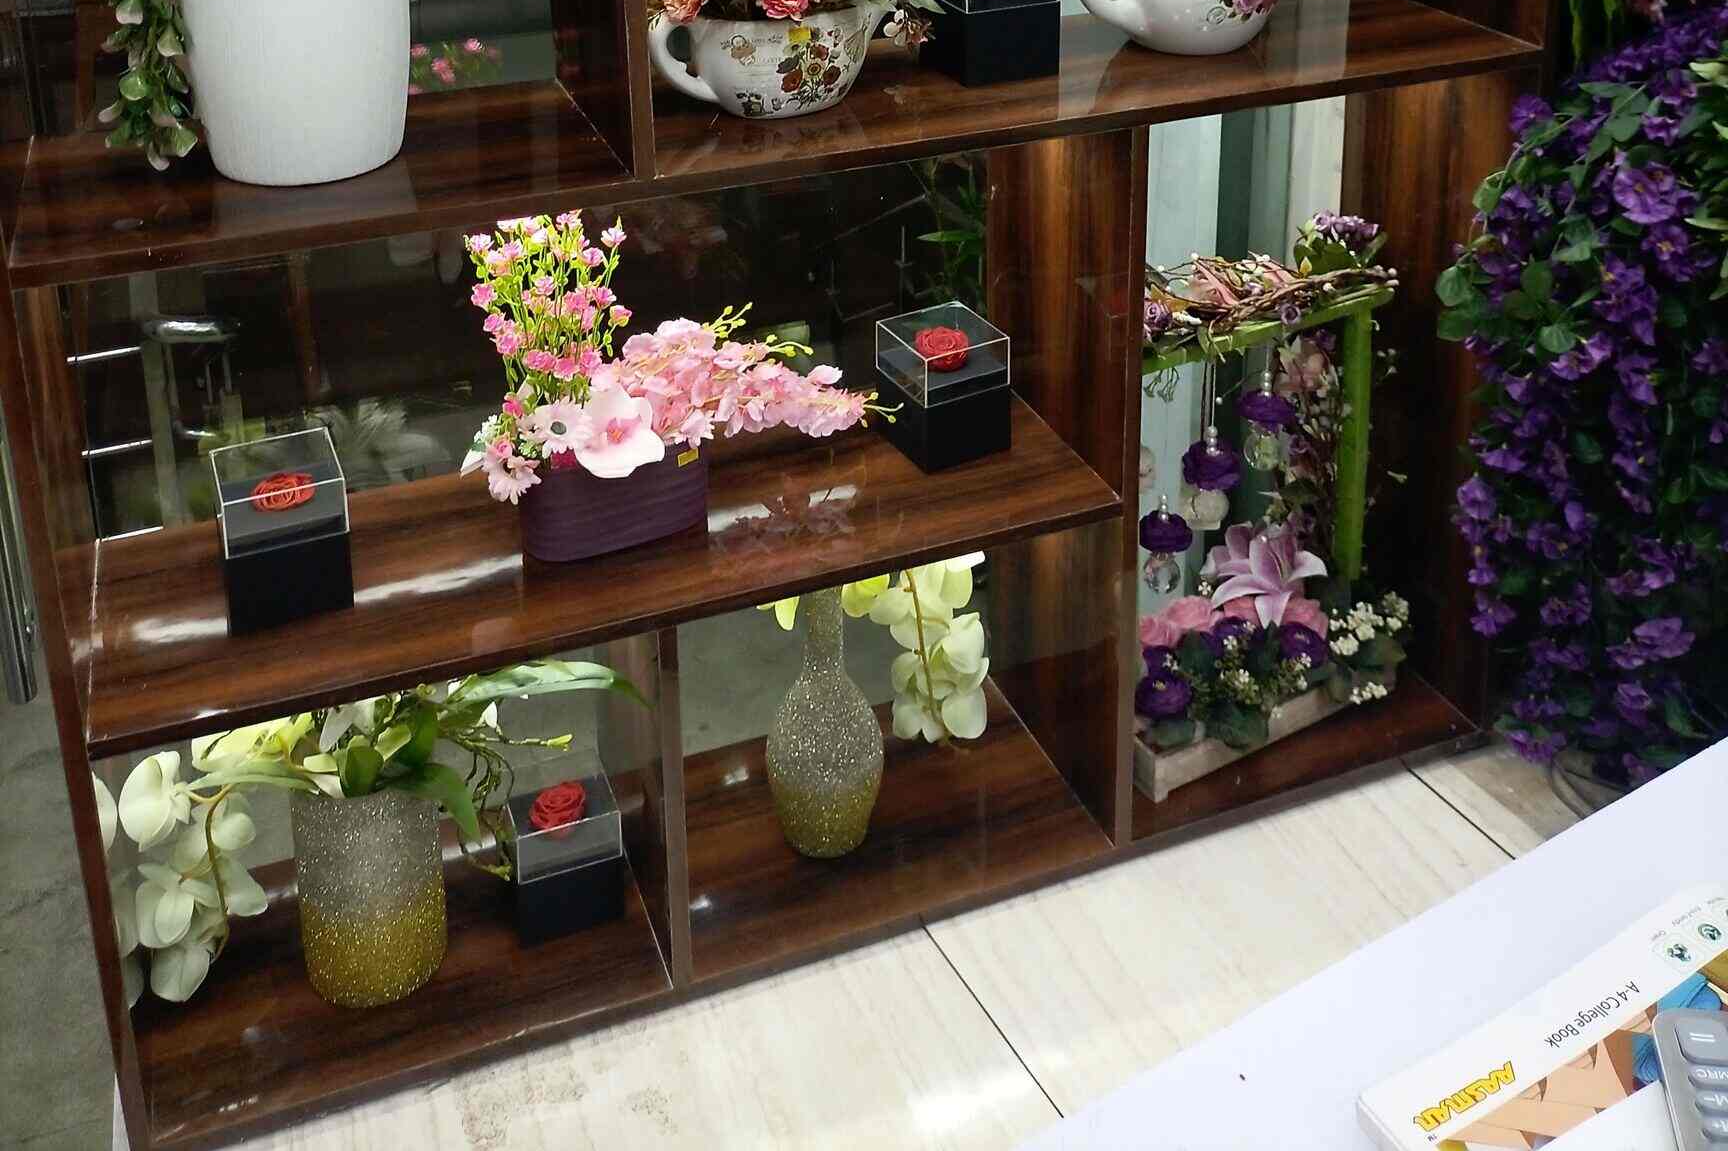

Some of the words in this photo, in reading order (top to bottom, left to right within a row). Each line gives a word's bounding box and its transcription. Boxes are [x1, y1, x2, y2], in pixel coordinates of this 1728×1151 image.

[1616, 980, 1640, 1002] A-4
[1574, 996, 1620, 1028] College
[1544, 1023, 1580, 1048] Book
